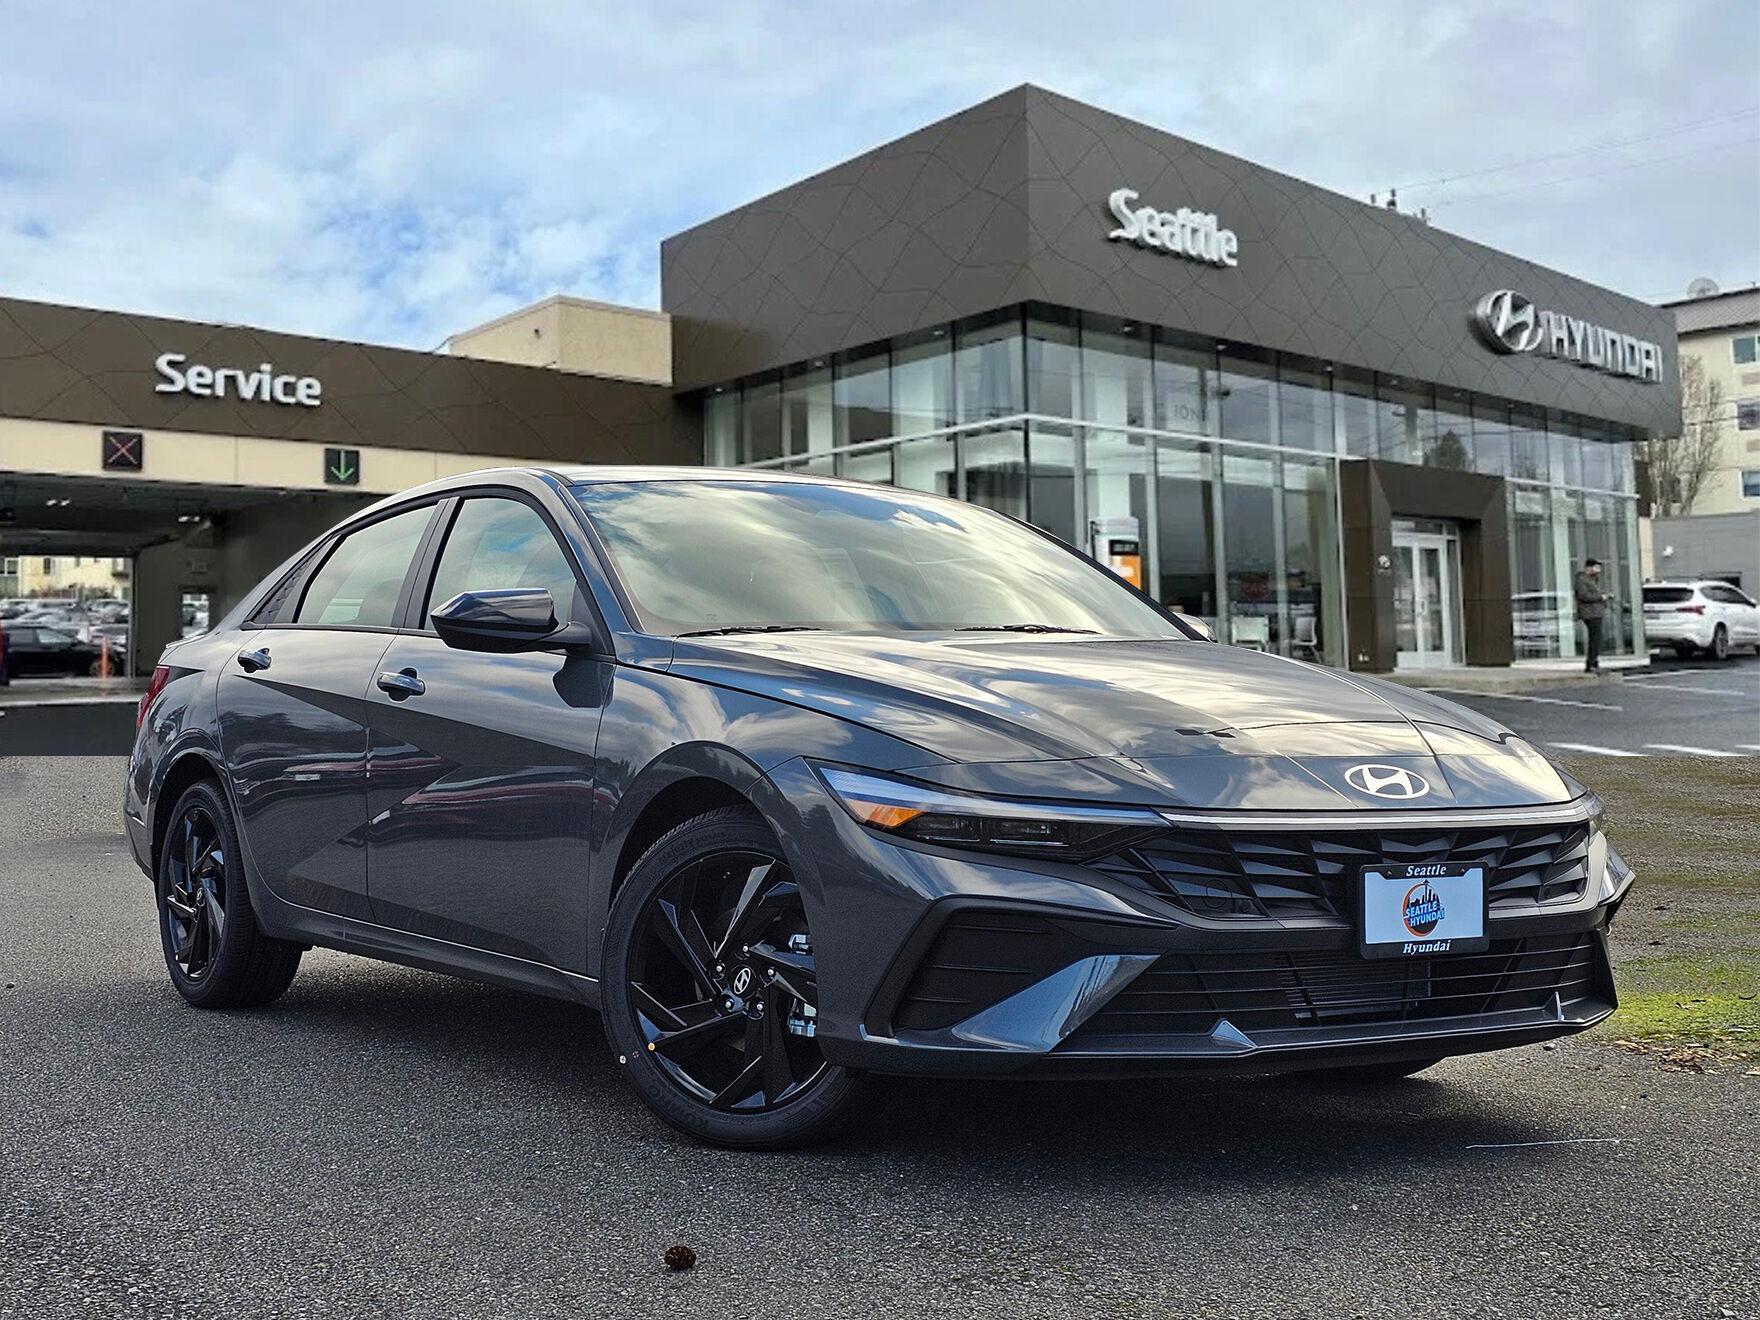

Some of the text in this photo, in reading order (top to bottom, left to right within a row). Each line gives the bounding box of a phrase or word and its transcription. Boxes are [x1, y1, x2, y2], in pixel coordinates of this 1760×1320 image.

[1109, 188, 1238, 267] Seattle
[1538, 311, 1663, 383] HYUNDAI
[155, 352, 322, 406] Service
[1406, 865, 1447, 877] Seattle
[1405, 901, 1437, 917] SEATTLE
[1410, 909, 1445, 926] HYUNDAI
[1403, 940, 1451, 955] Hyundai
